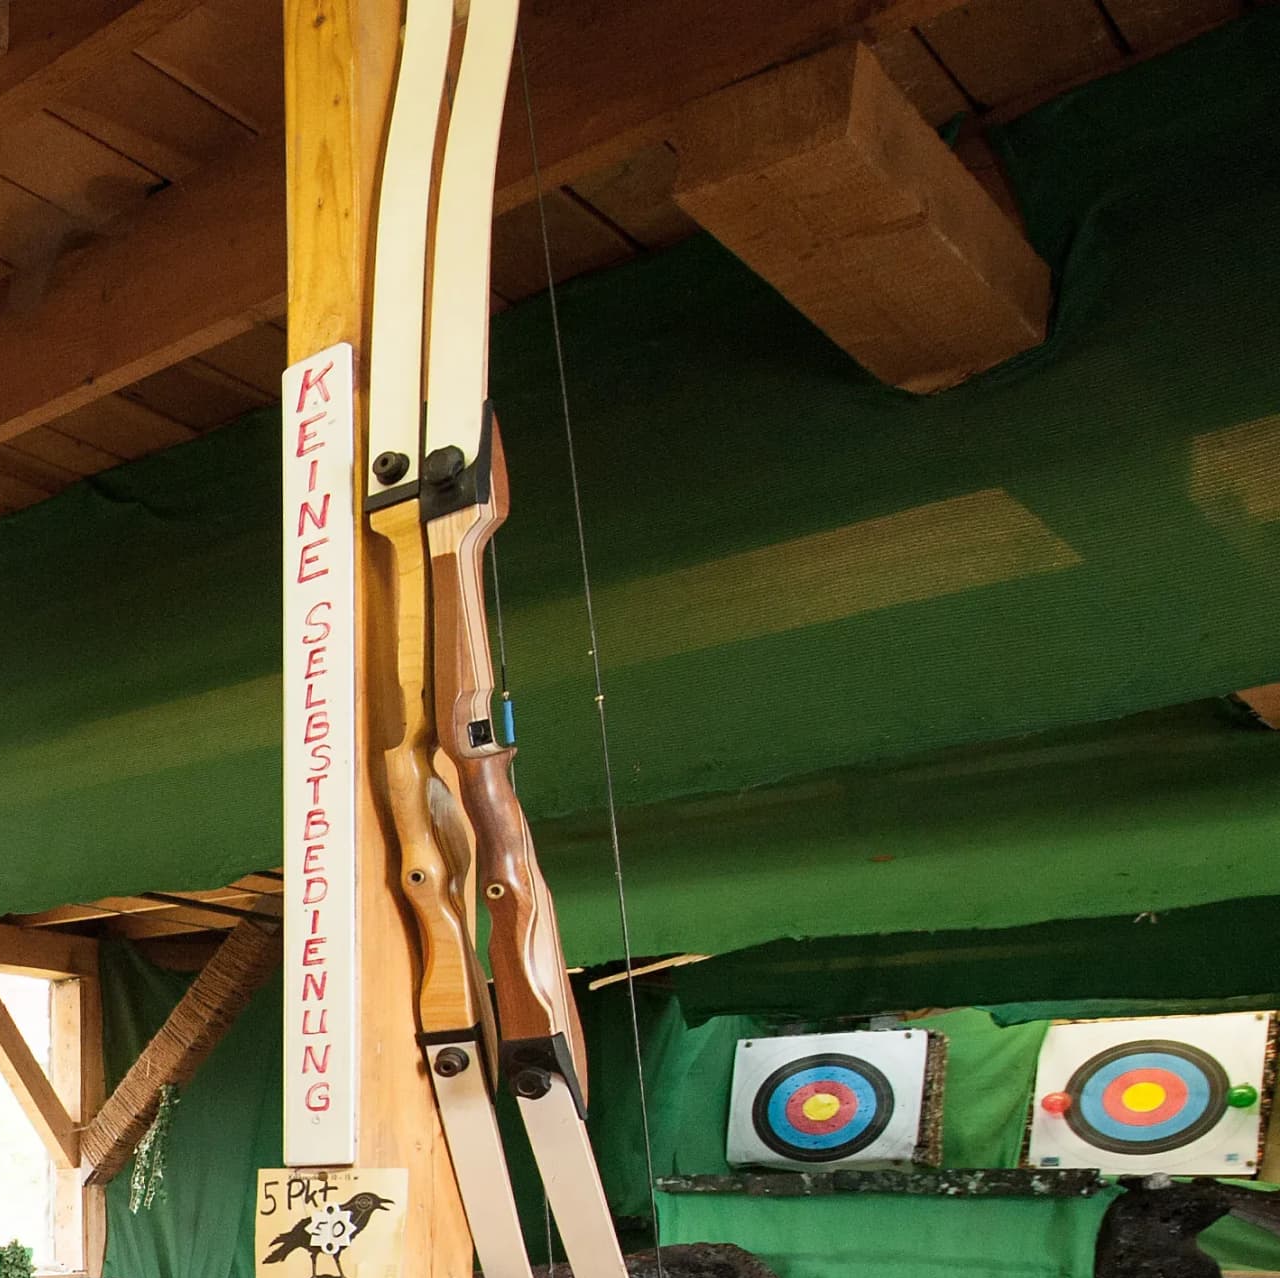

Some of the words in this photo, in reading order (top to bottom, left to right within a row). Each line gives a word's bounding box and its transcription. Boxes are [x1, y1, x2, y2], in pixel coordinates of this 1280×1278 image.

[295, 361, 335, 584] KEINE
[301, 601, 334, 1113] SELBSTBEDIENUNG
[259, 1181, 280, 1216] 5
[286, 1178, 339, 1211] Pkt
[310, 1220, 346, 1239] 50
